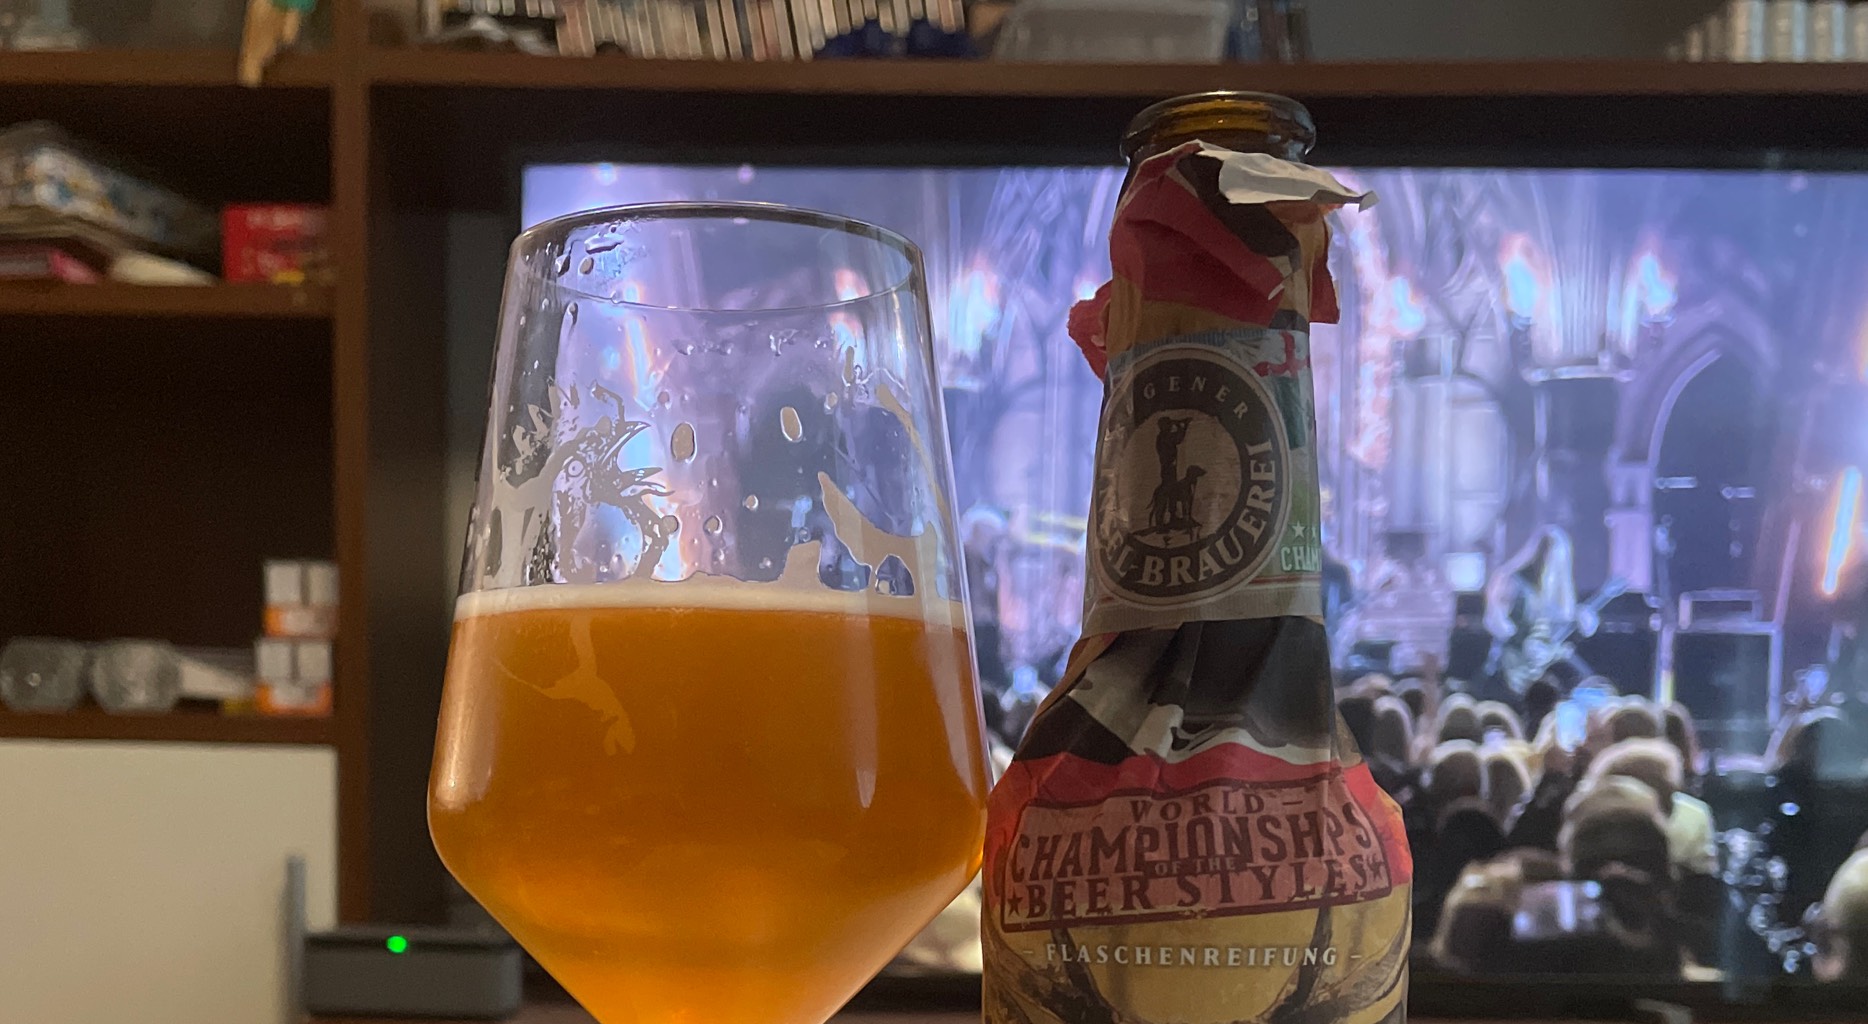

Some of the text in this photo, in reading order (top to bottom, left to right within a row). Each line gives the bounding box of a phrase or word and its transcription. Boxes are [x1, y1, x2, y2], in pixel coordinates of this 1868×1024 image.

[1143, 375, 1248, 419] GENER
[1281, 545, 1322, 571] CHAM
[1131, 789, 1265, 823] WORLD
[1011, 803, 1371, 882] CHAMPIONSHPS
[1155, 857, 1236, 876] OF THE
[1026, 859, 1367, 918] BEER STYLES
[1047, 944, 1337, 967] FLASCHENREIFUNG
